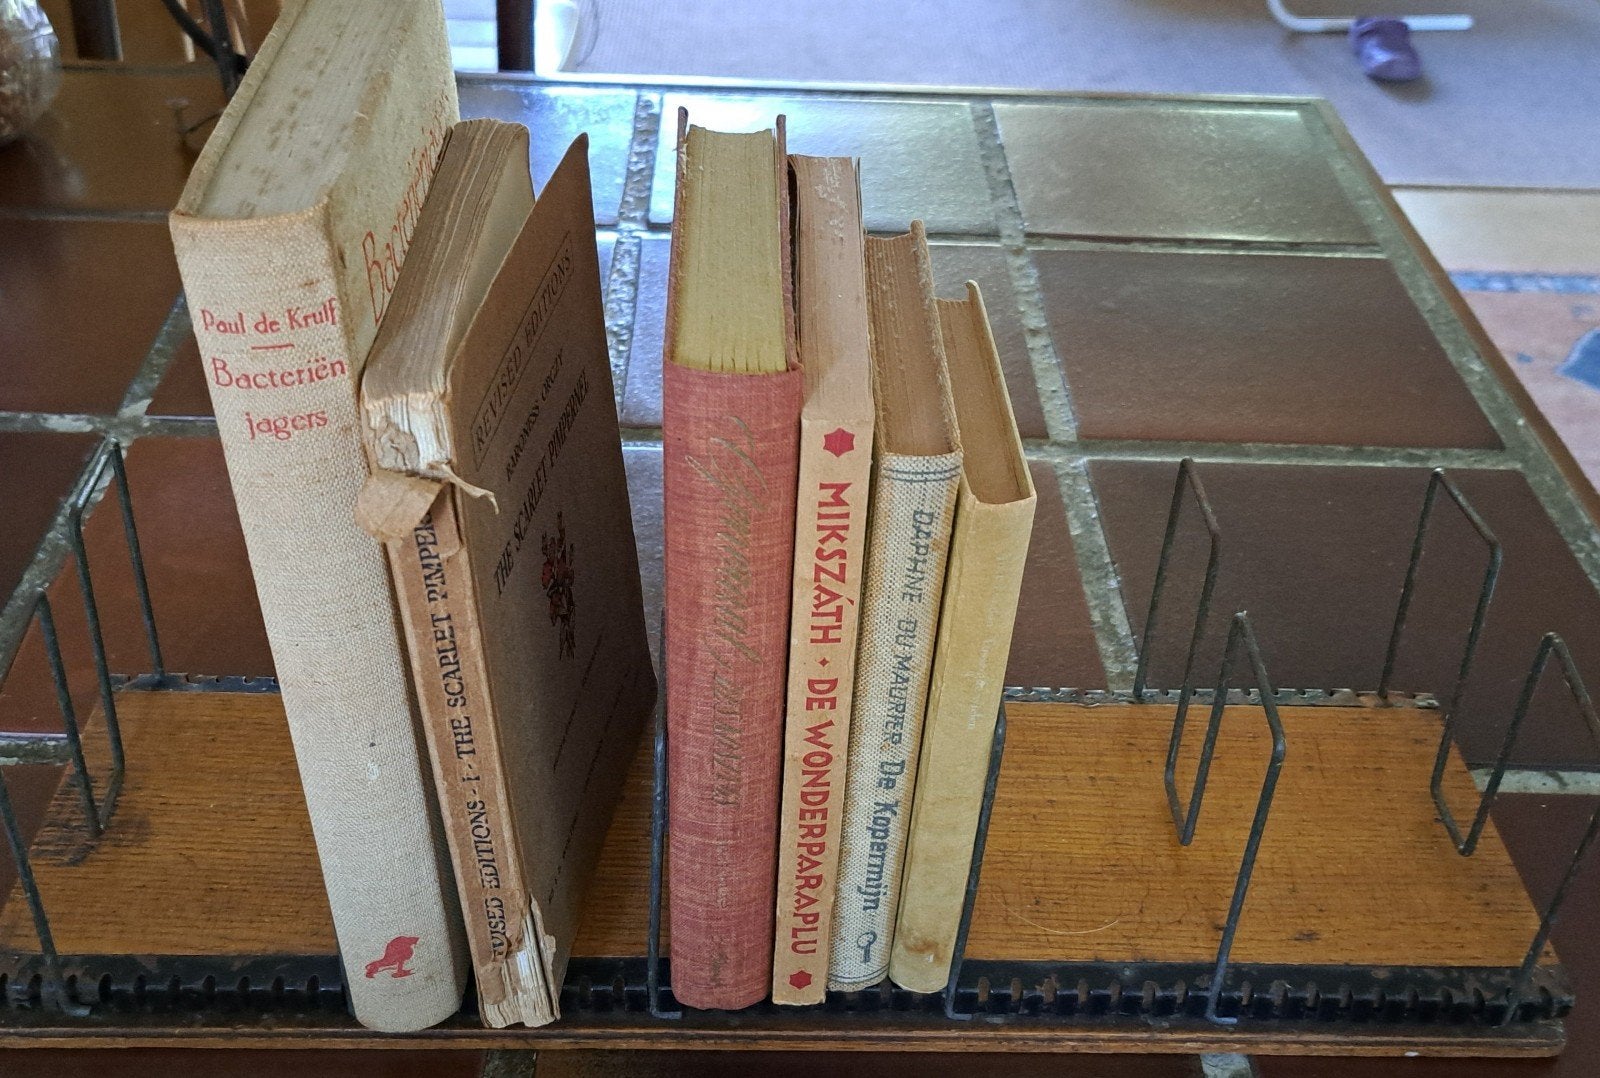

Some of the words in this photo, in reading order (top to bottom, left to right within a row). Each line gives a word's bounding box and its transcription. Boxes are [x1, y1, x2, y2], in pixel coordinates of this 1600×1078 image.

[202, 308, 246, 334] Paul
[253, 312, 281, 334] de
[475, 346, 522, 451] REVISED
[524, 249, 571, 348] EDITIONS
[212, 356, 346, 389] Bacteriën
[245, 410, 328, 441] jagers
[493, 541, 514, 595] THE
[513, 455, 549, 552] SCARLET
[548, 366, 589, 468] PIMPERNEL
[809, 482, 855, 645] MIKSZÁTH
[901, 509, 934, 604] DAPHNE
[452, 716, 476, 760] THE
[805, 677, 839, 712] DE
[884, 653, 913, 746] MAURIER
[878, 759, 906, 790] De
[466, 800, 500, 889] EDITIONS
[789, 719, 835, 955] WONDERPARAPLU
[857, 800, 899, 912] Kopermijn
